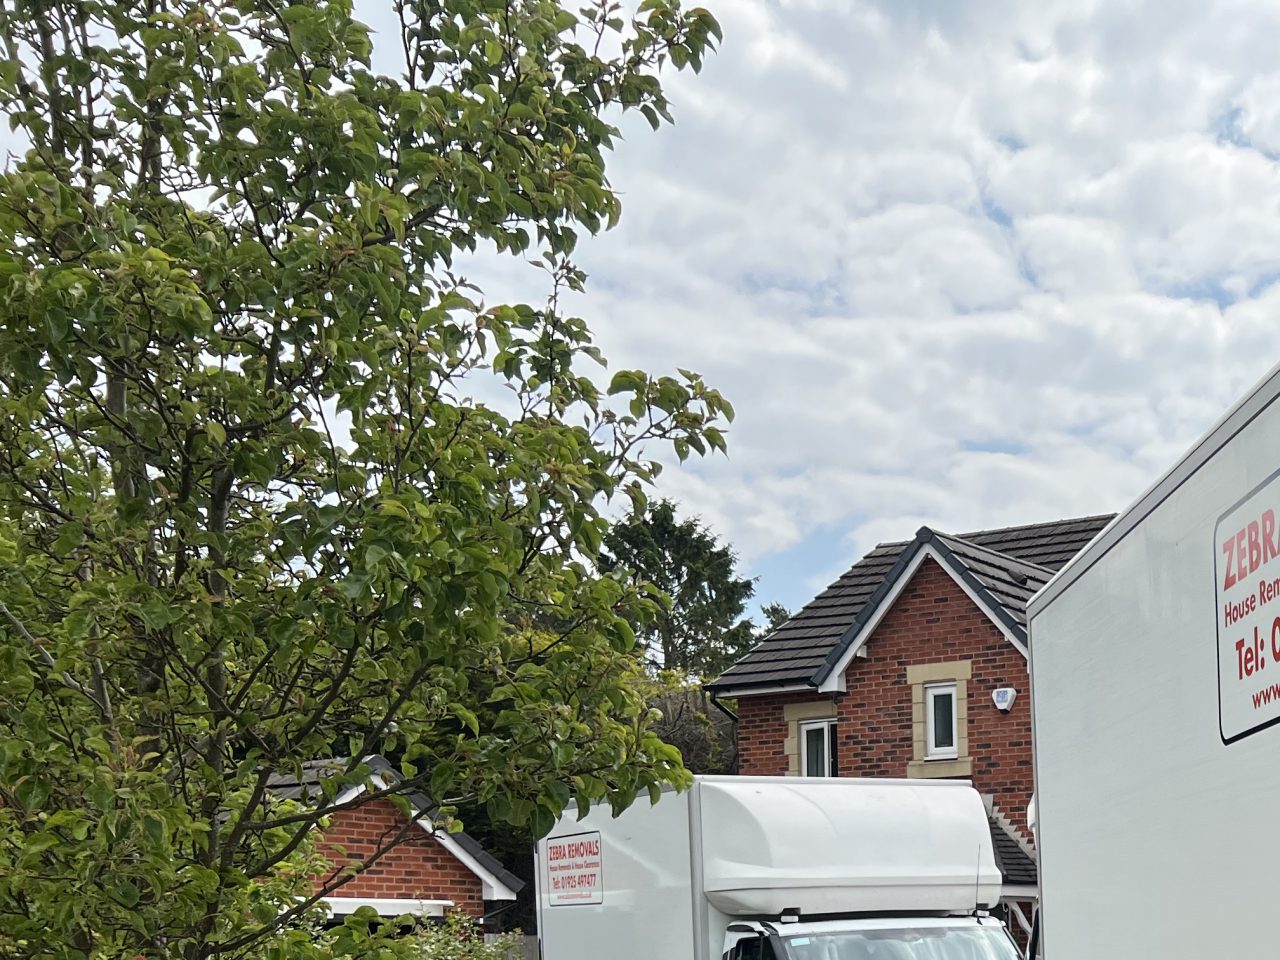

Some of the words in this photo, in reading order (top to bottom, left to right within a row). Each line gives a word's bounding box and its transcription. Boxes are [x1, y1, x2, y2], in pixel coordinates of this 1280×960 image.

[1224, 595, 1257, 628] House
[1235, 625, 1265, 681] Tel:
[549, 845, 566, 861] ZEBRA
[568, 840, 599, 858] REMOVALS
